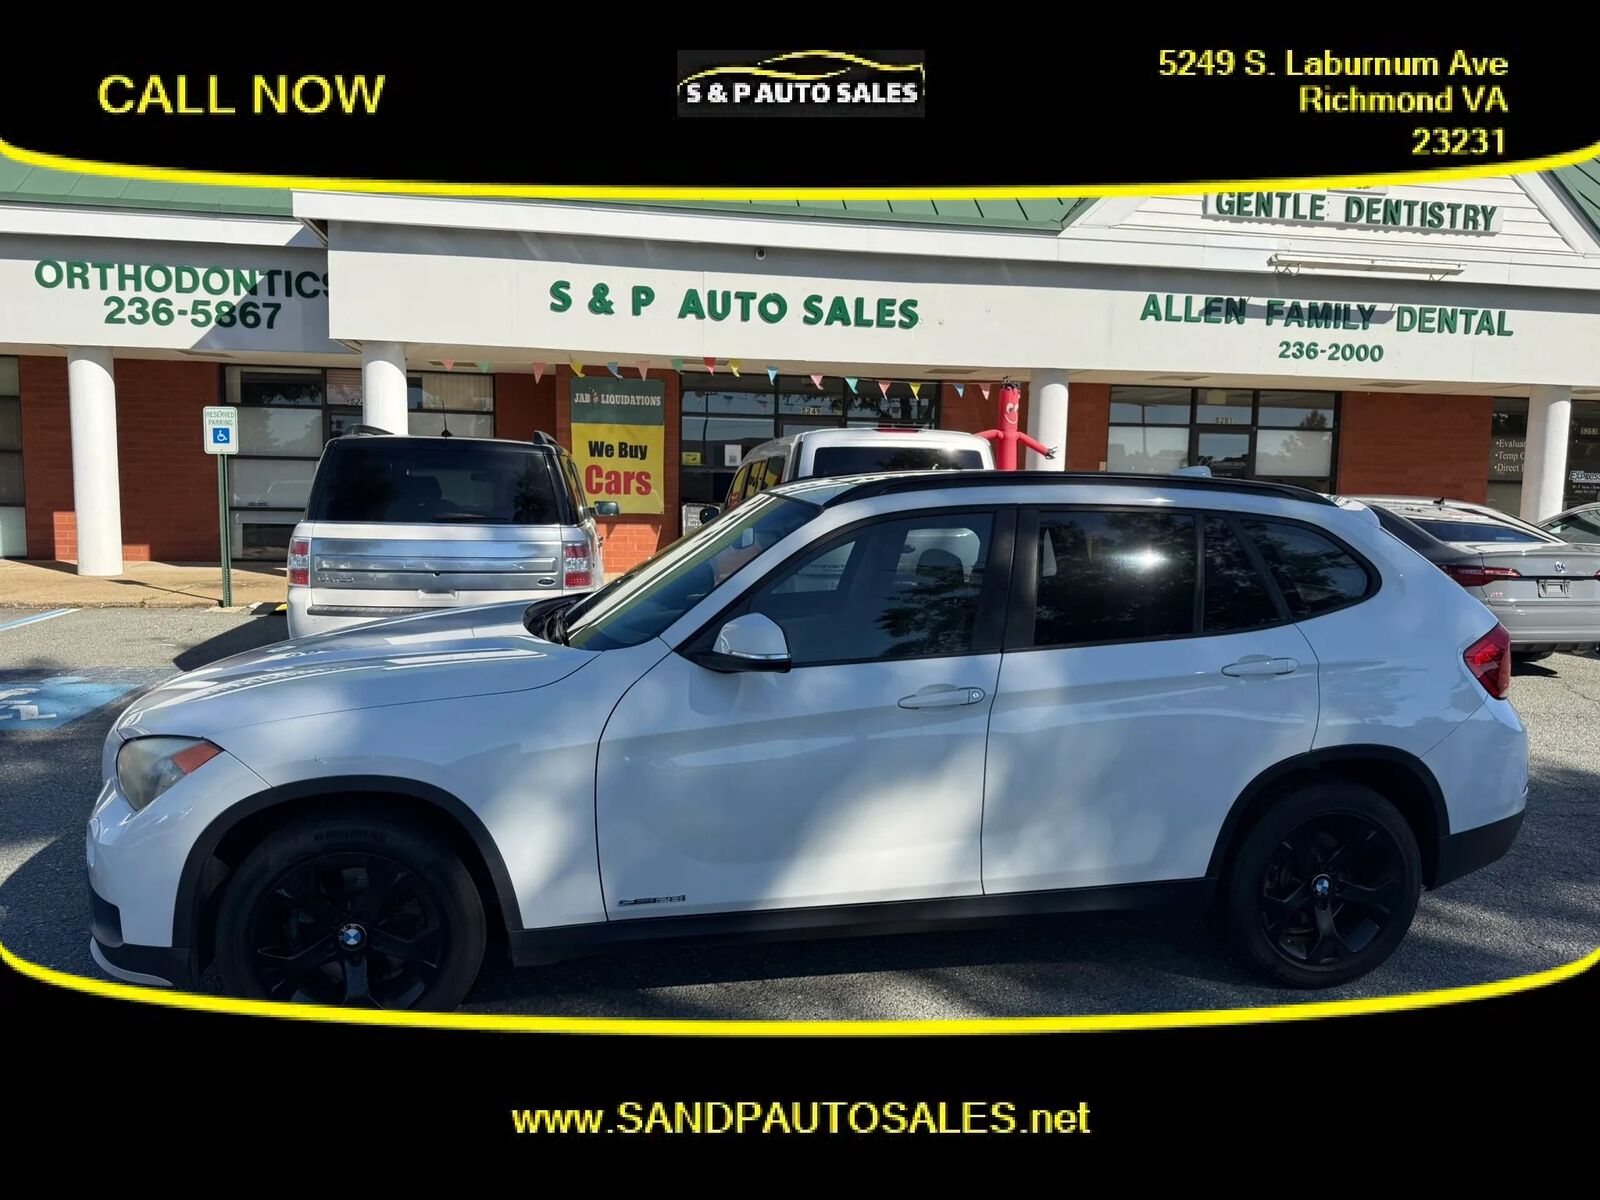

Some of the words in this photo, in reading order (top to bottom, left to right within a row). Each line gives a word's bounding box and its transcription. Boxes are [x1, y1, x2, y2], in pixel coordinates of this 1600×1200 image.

[1216, 191, 1326, 221] GENTLE
[1345, 195, 1497, 231] DENTISTRY
[35, 259, 329, 299] ORTHODONTIC
[104, 295, 283, 330] 236-5867
[549, 280, 574, 313] S
[587, 283, 616, 316] &
[631, 285, 656, 317] P
[677, 288, 789, 324] AUTO
[803, 295, 920, 330] SALES
[1140, 293, 1247, 325] ALLEN
[1265, 299, 1377, 331] FAMILY
[1396, 306, 1514, 337] DENTAL
[1278, 340, 1385, 363] 236-2000
[600, 393, 662, 407] LIQUIDATIONS
[205, 410, 235, 418] RESERVED
[208, 418, 234, 426] PARKING
[588, 440, 616, 458] We
[617, 441, 649, 461] Buy
[1498, 451, 1519, 462] Temp
[1497, 463, 1520, 472] Direct
[584, 464, 652, 496] Cars
